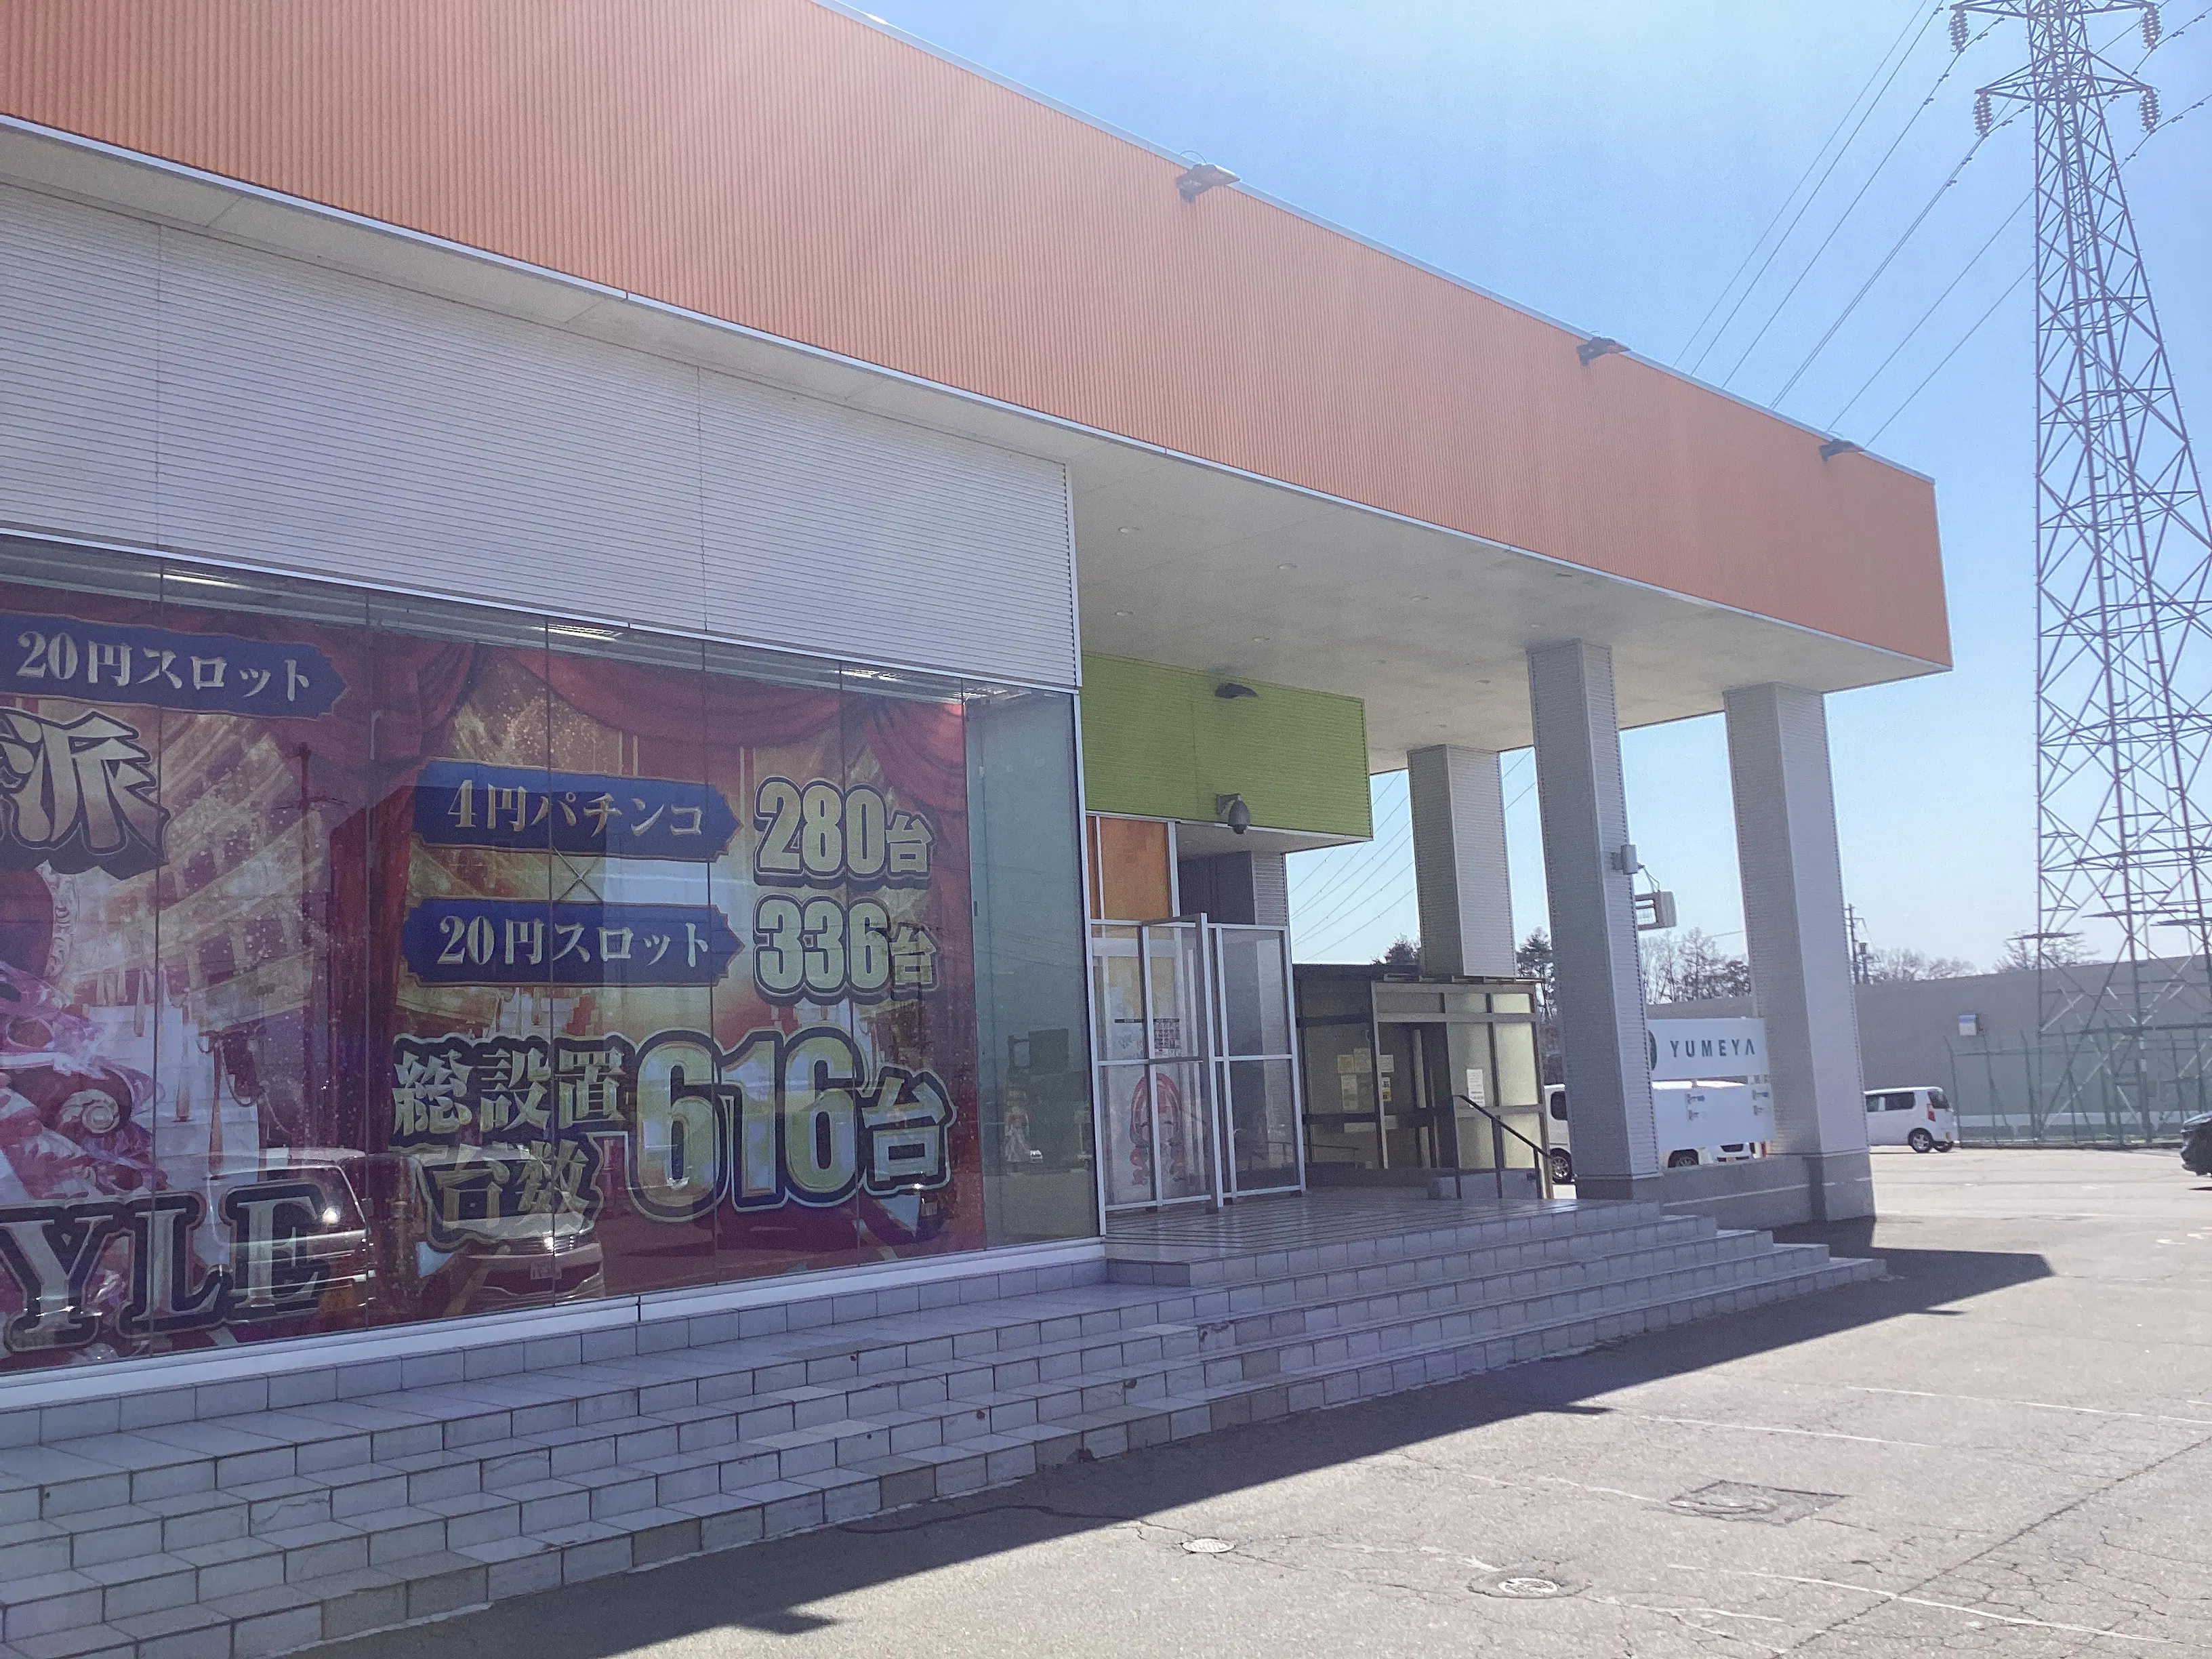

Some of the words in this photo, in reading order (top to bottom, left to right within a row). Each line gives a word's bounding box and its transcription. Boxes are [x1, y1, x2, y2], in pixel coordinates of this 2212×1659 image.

[17, 630, 310, 701] 20円スロット
[447, 779, 703, 837] 4円パチンコ
[757, 781, 933, 877] 280台
[438, 916, 710, 968] 20円スロット
[757, 899, 937, 989] 336台
[393, 1047, 628, 1137] 総設置
[636, 1035, 946, 1208] 616台
[432, 1139, 591, 1229] 台数
